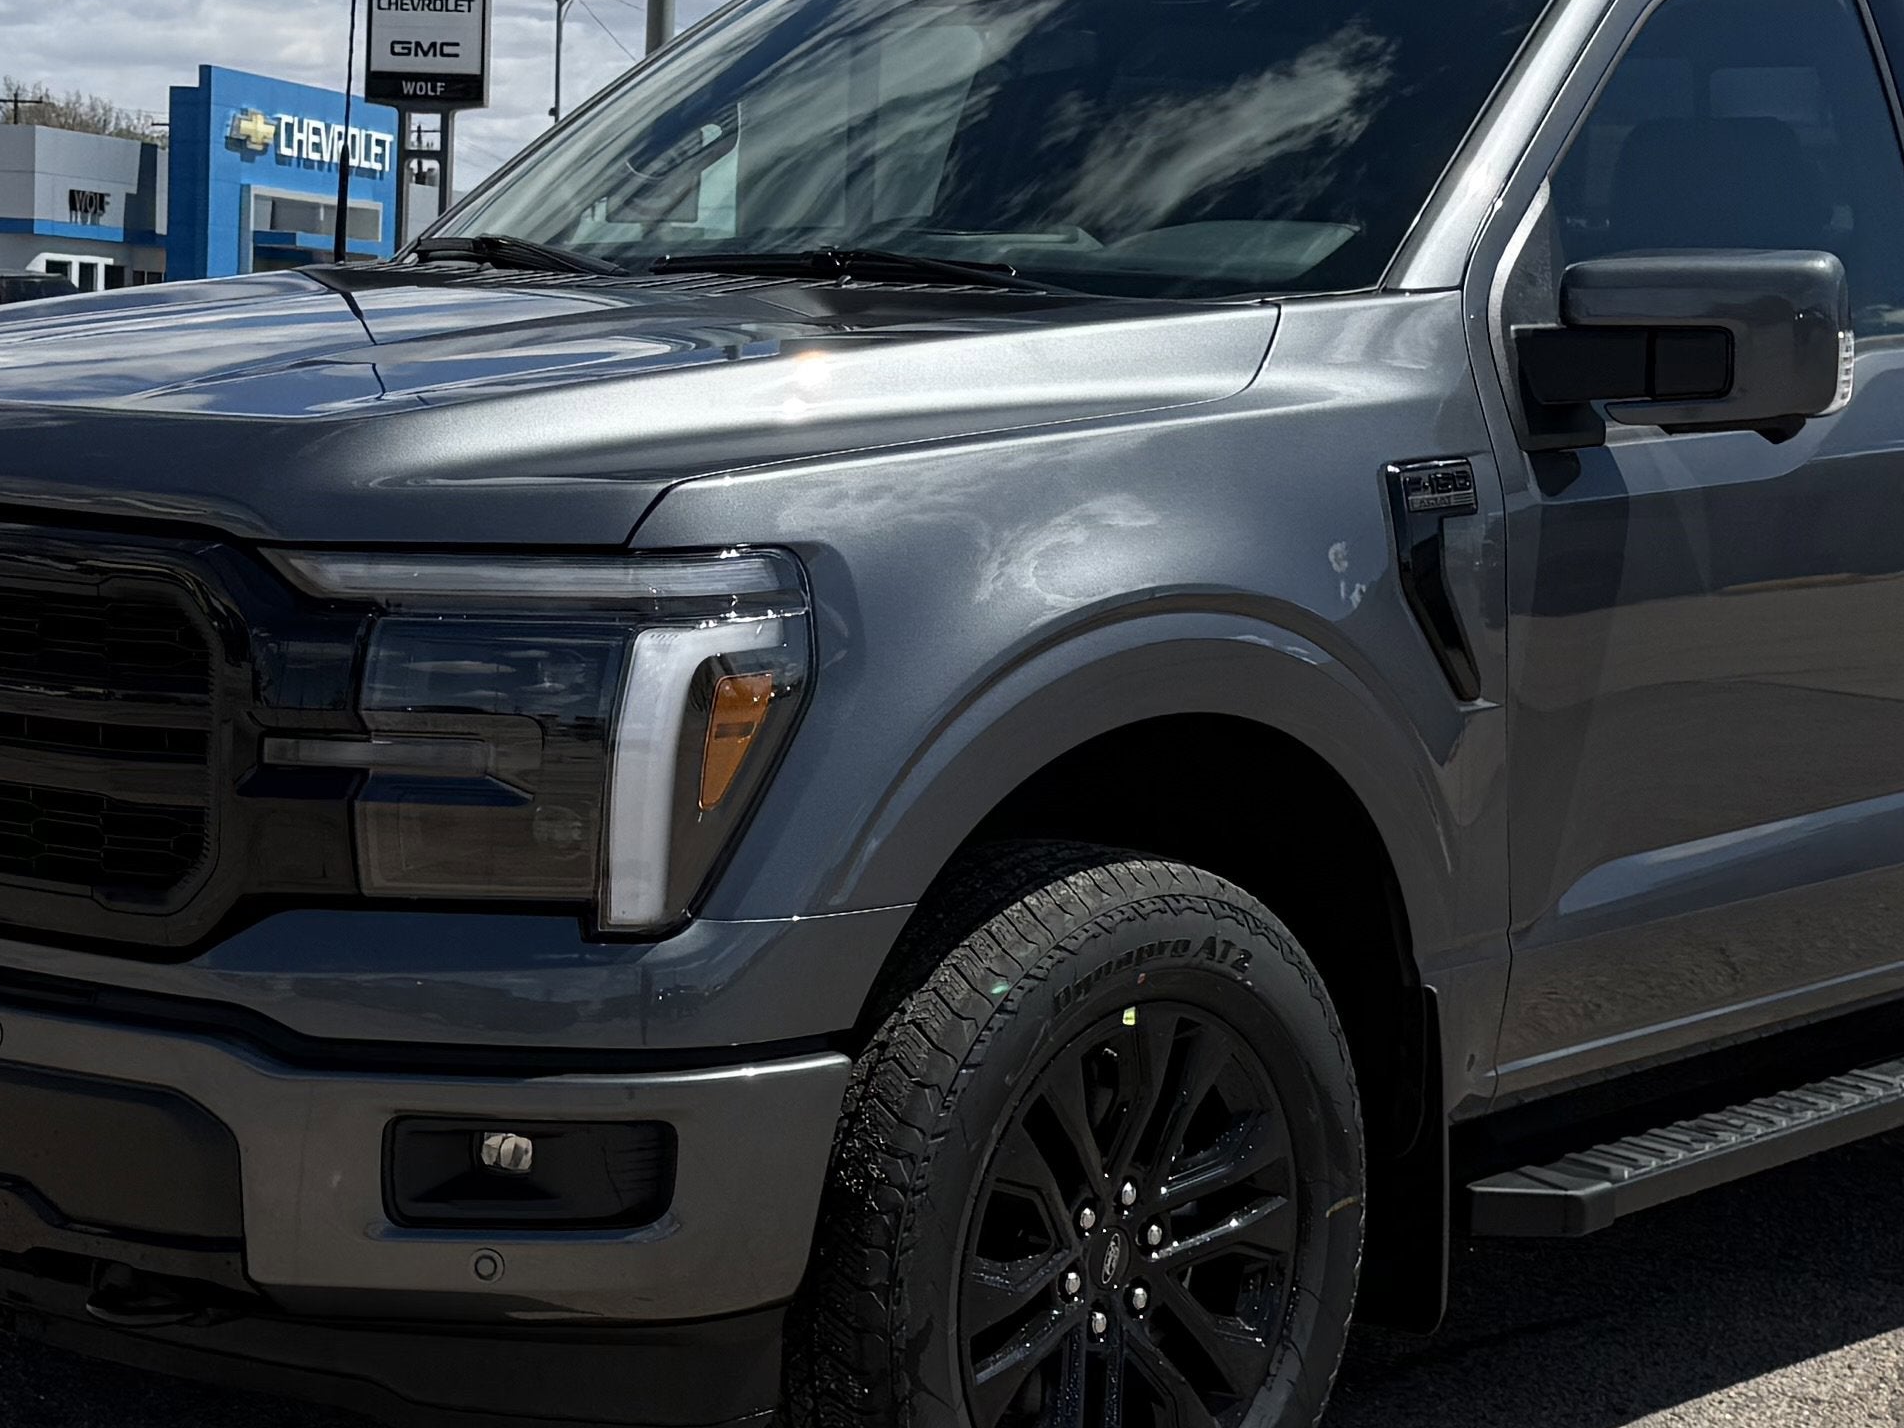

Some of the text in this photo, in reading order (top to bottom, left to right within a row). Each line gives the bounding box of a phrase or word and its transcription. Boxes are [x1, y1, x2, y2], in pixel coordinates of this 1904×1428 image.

[390, 40, 460, 58] GMC
[402, 80, 446, 96] WOLF
[274, 113, 394, 172] CHEVROLET
[1193, 935, 1254, 974] AT2
